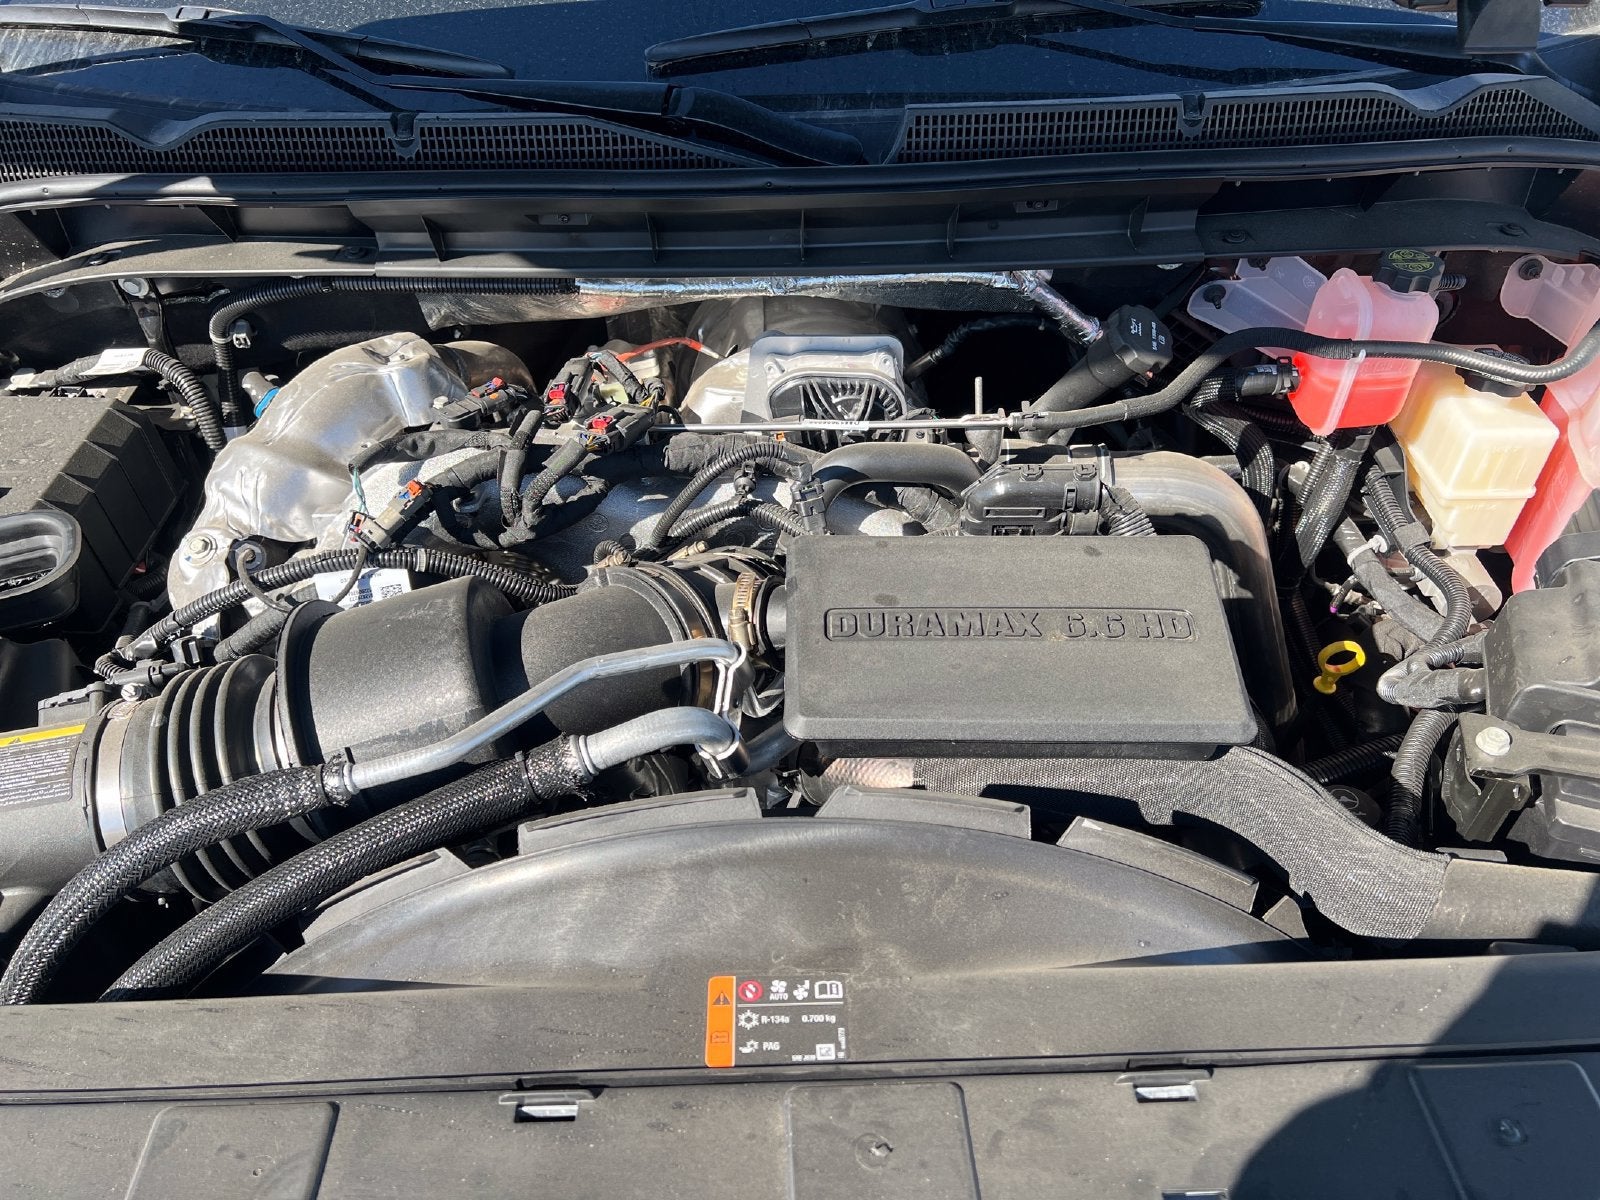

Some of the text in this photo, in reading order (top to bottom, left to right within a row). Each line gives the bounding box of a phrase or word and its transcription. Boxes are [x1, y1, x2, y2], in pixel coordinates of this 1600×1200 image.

[829, 611, 1193, 640] DURAMAX 6.6 HD
[769, 993, 789, 1001] AUTO
[761, 1014, 836, 1024] R-134a 0.700 kg
[762, 1041, 780, 1051] PAG
